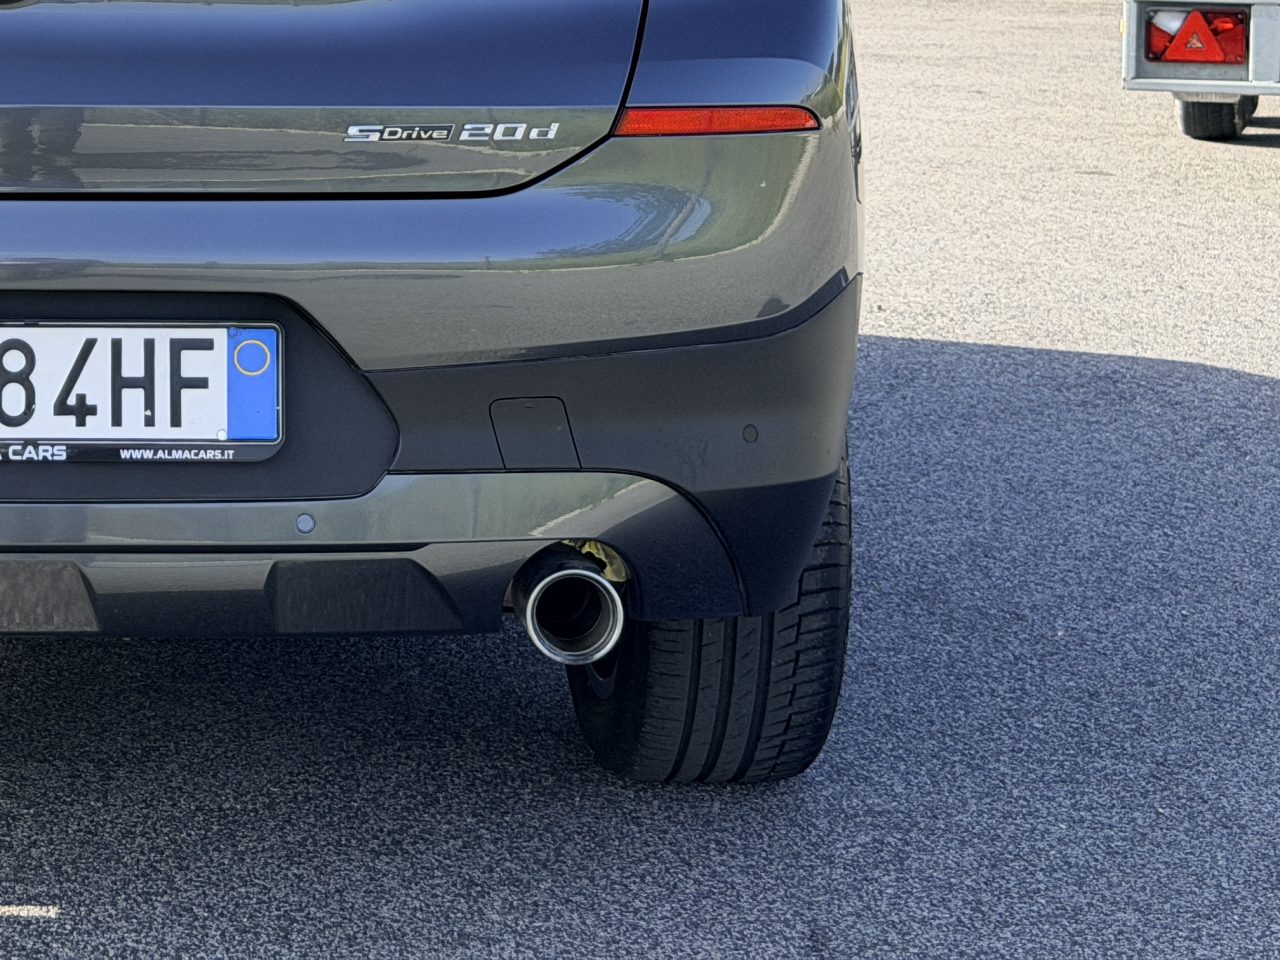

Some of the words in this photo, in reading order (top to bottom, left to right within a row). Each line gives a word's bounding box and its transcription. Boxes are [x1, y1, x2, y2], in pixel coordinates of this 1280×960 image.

[459, 122, 560, 141] 20d
[8, 445, 67, 461] CARS
[119, 449, 235, 460] WWW.ALMACARS.IT
